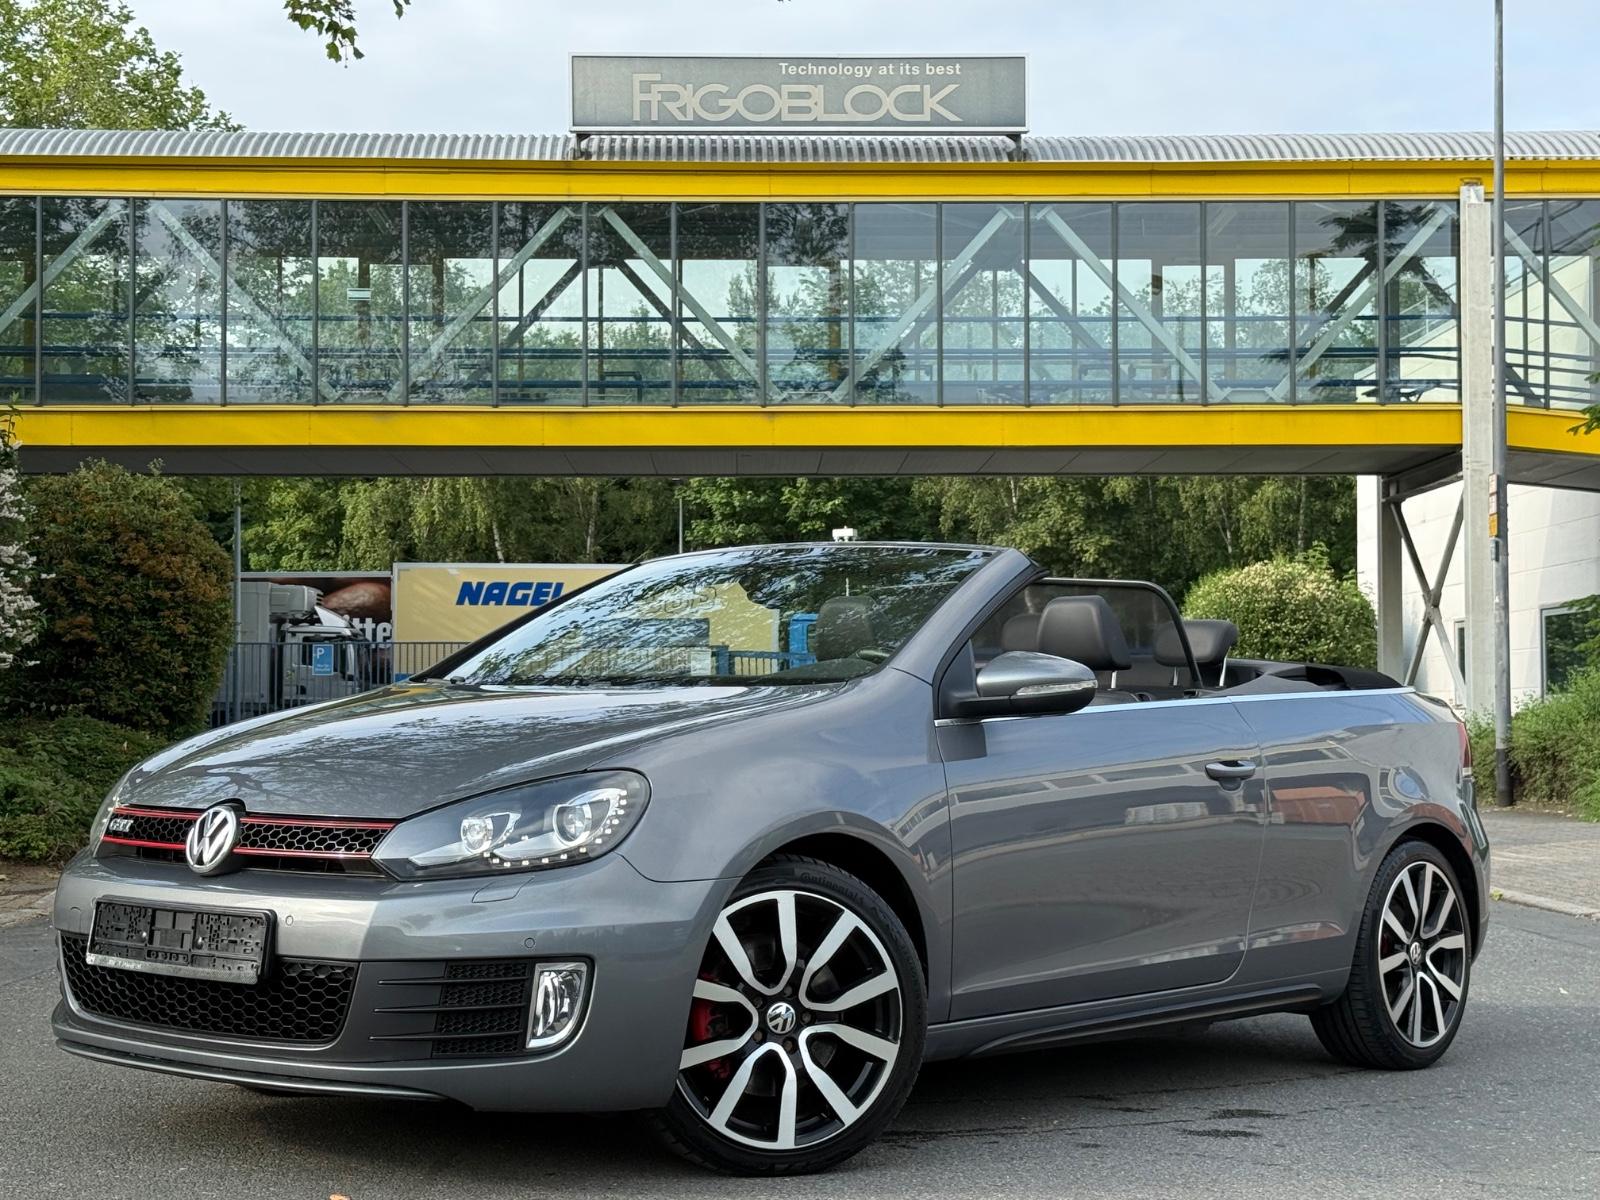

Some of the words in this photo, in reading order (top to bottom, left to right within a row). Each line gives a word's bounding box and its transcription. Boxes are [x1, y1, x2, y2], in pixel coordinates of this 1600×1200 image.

[779, 62, 873, 78] Technology
[878, 63, 895, 76] at
[899, 62, 921, 76] its
[926, 62, 961, 76] best
[632, 73, 964, 122] FRIGOBLOCK
[316, 647, 325, 660] P
[108, 818, 134, 832] GTI
